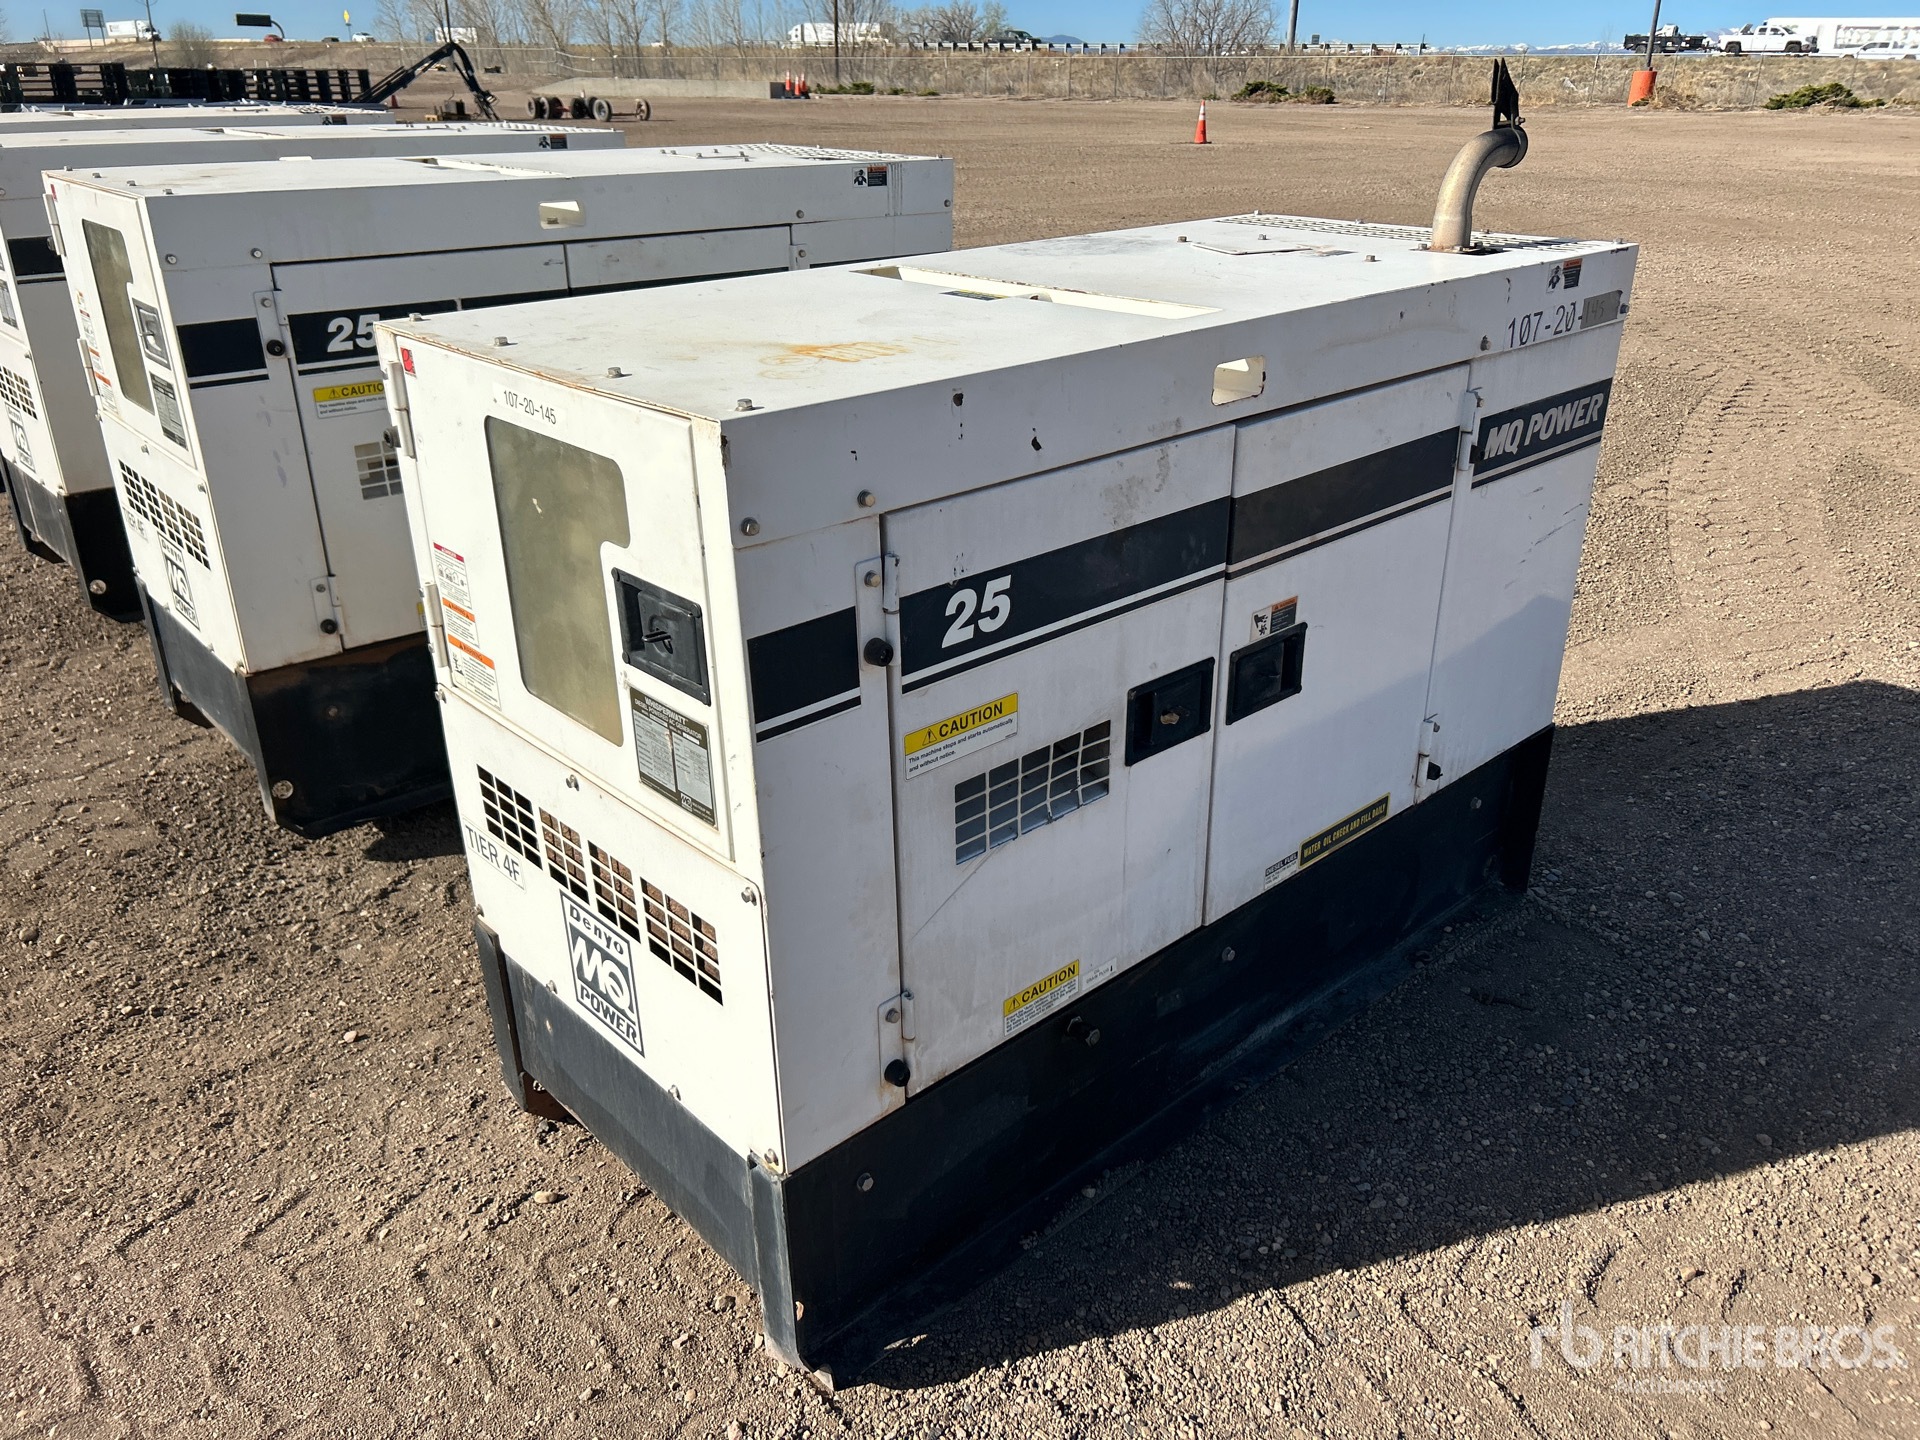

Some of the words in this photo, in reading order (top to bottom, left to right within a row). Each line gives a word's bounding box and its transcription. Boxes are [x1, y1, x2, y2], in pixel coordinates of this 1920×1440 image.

[327, 313, 380, 352] 25
[341, 382, 385, 397] CAUTIO
[503, 390, 557, 424] 107-20-145
[1483, 418, 1524, 460] MQ
[1524, 393, 1604, 446] POWER
[942, 574, 1011, 648] 25
[921, 747, 942, 758] machine
[943, 742, 956, 751] stops
[968, 730, 981, 740] starts
[982, 718, 1013, 734] automatically
[939, 702, 1003, 737] CAUTION
[920, 755, 939, 767] without
[940, 751, 956, 760] notice.
[1304, 841, 1321, 858] WATER
[1323, 835, 1332, 847] OIL
[1333, 824, 1350, 841] CHECK
[1350, 818, 1360, 831] AND
[1361, 812, 1371, 825] FILL
[1372, 803, 1386, 818] DAILY
[465, 825, 500, 868] TIER
[503, 854, 520, 881] 4F
[569, 903, 624, 955] Denyo
[1021, 964, 1076, 1003] CAUTION
[580, 984, 638, 1045] POWER
